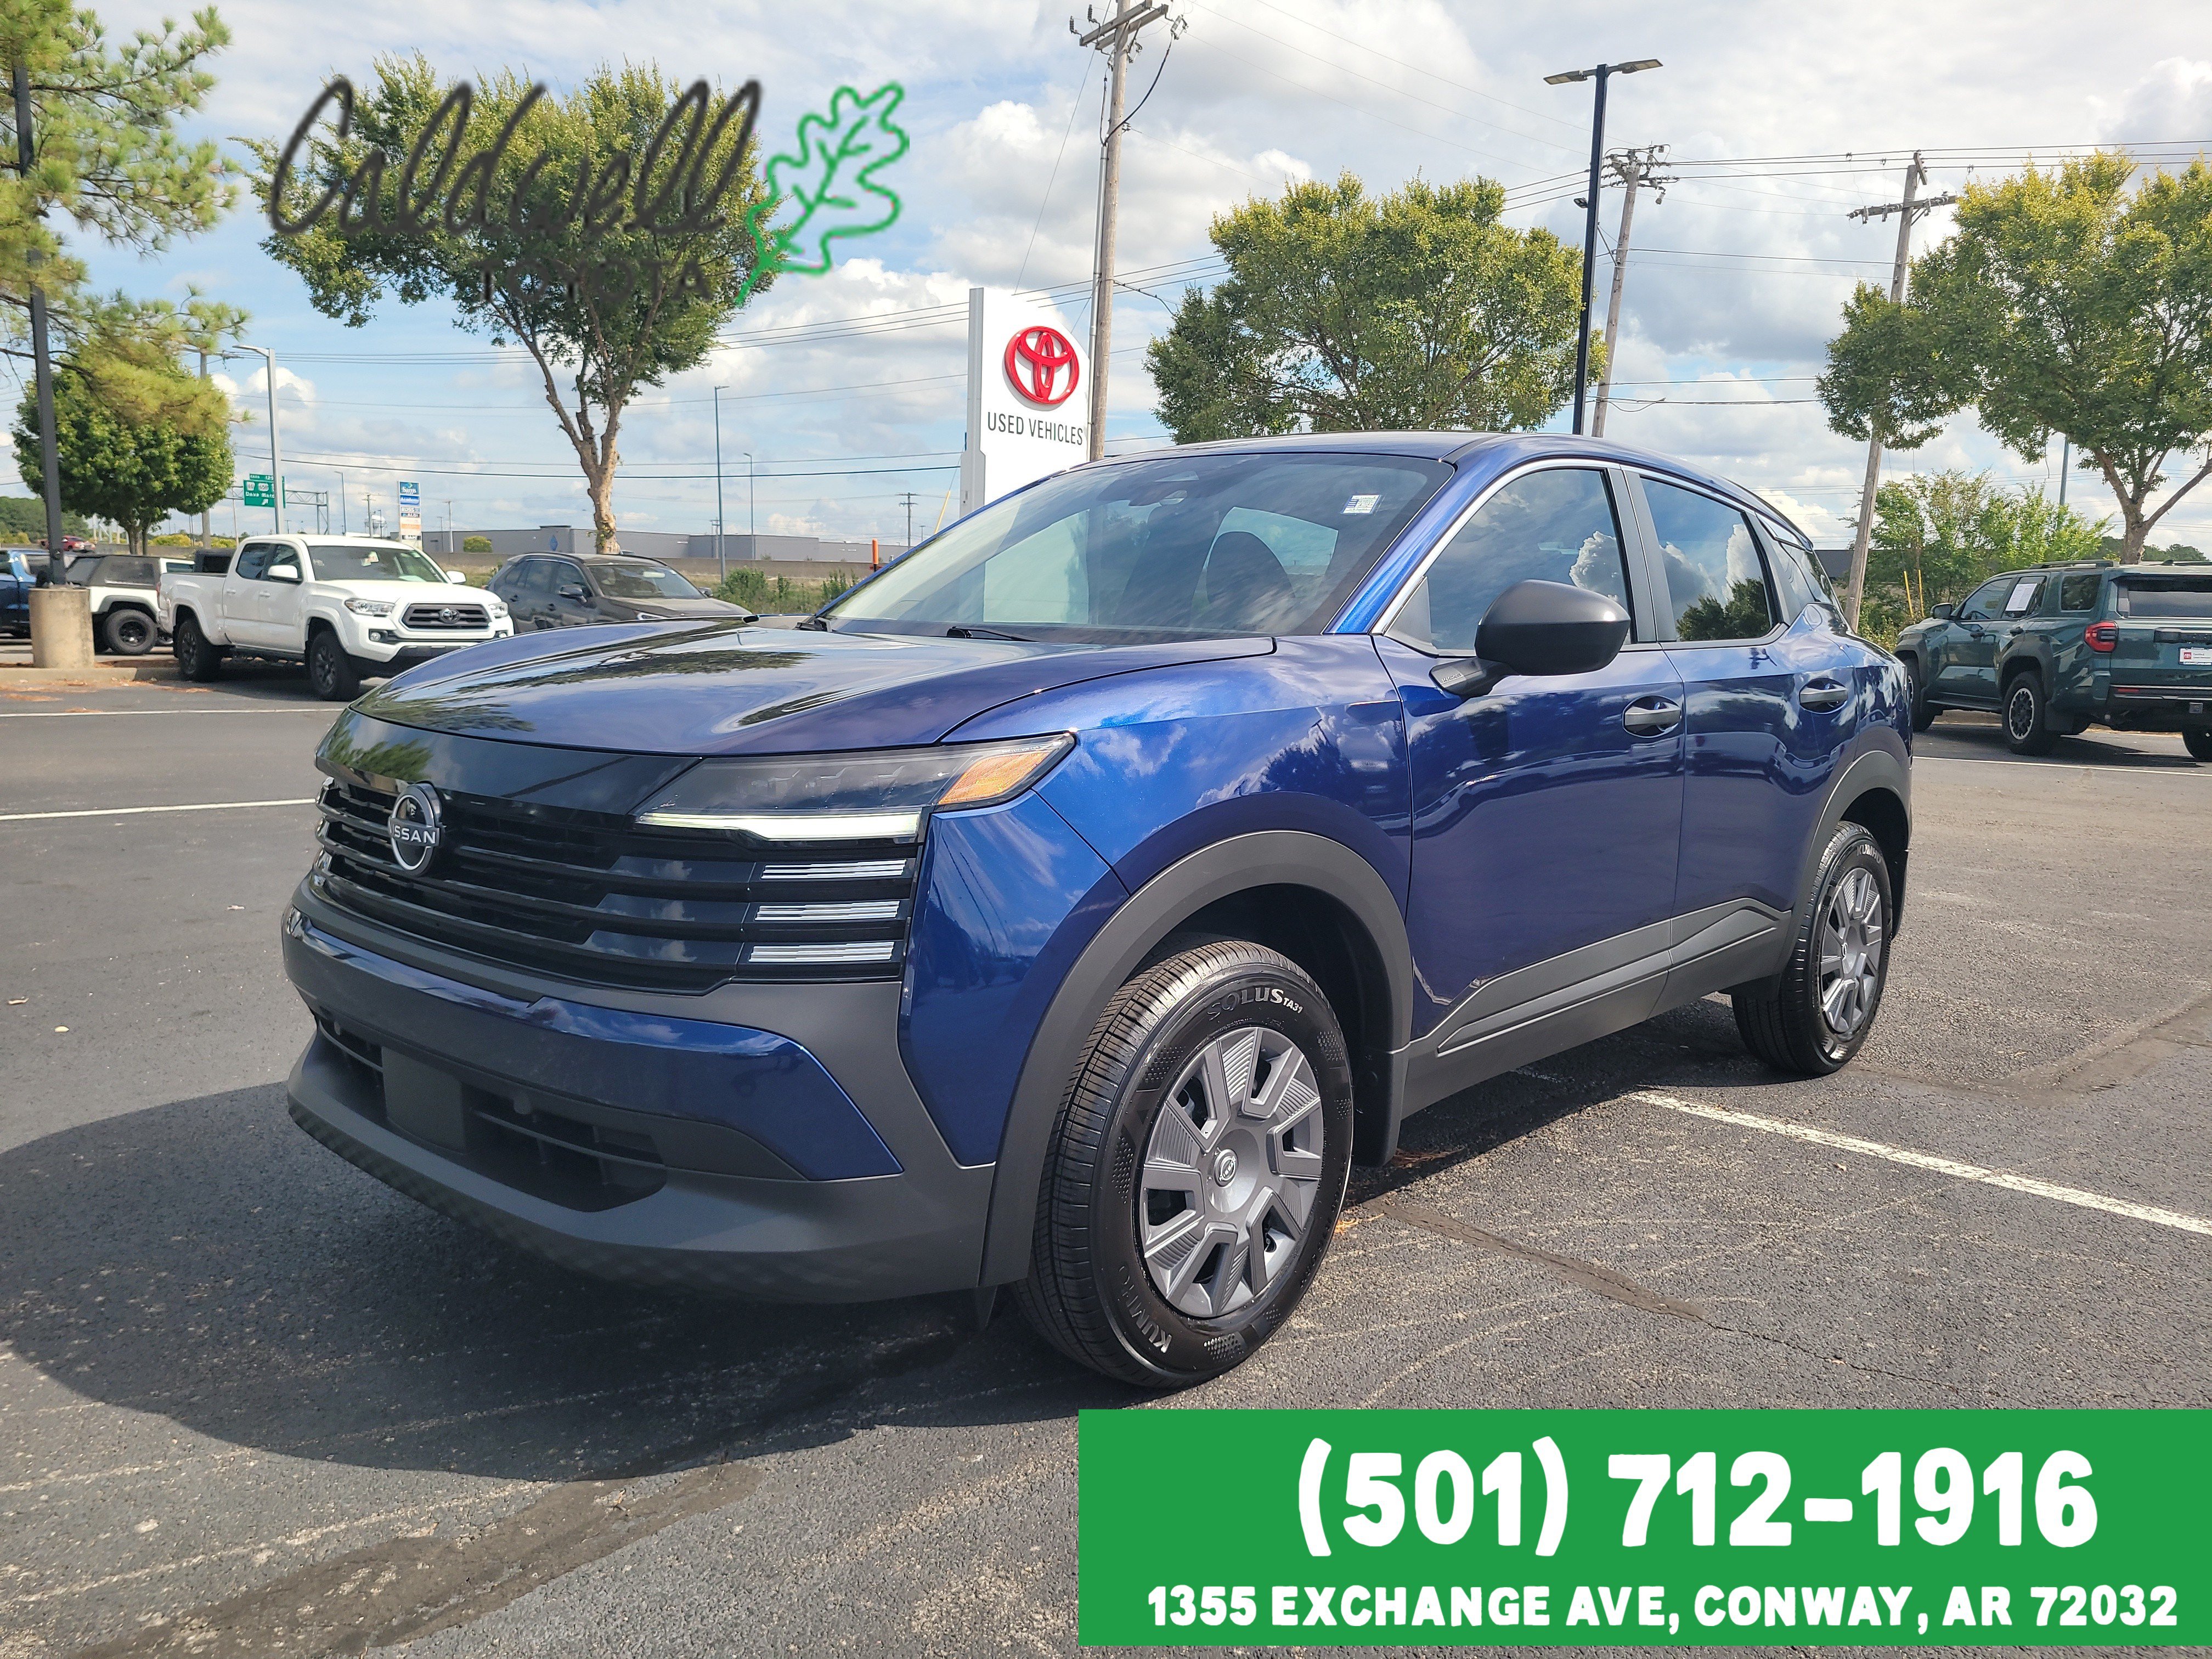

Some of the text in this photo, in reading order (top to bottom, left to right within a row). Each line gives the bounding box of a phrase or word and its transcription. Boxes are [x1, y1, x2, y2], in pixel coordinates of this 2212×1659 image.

[988, 411, 1084, 445] USED VEHICLES
[390, 823, 436, 844] ISSAN
[1857, 844, 1881, 864] KUMHO
[1207, 987, 1304, 1021] SOLUS TA31
